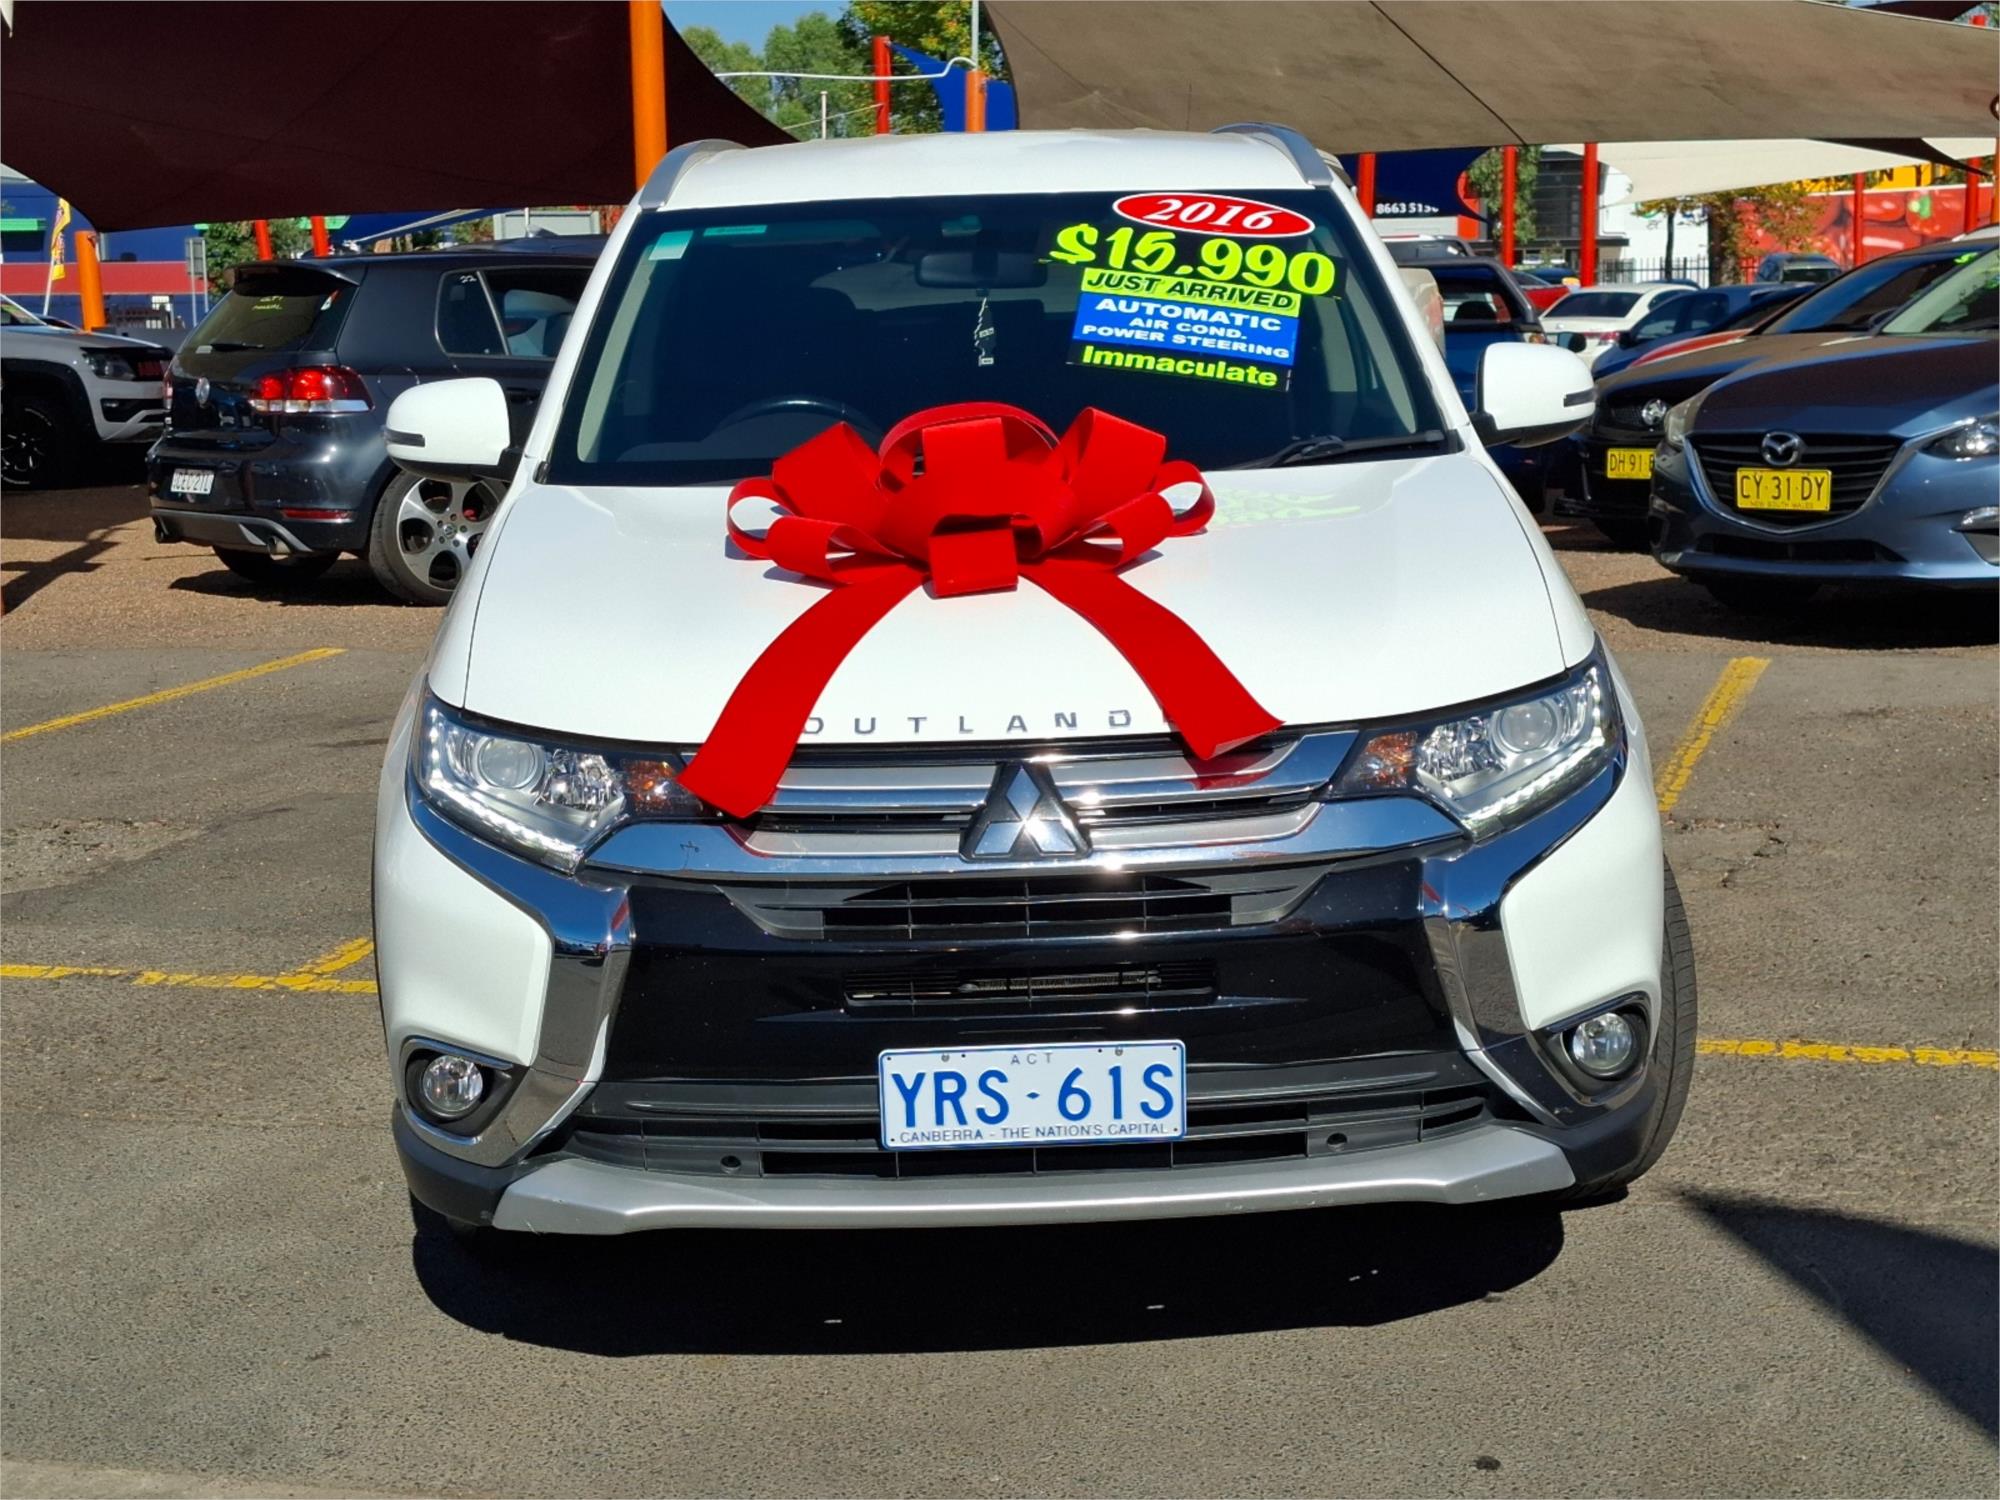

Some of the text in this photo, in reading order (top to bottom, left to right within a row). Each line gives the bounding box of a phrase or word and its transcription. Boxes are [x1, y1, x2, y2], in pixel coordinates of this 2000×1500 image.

[1142, 198, 1283, 231] 2016
[1376, 202, 1407, 214] 8663
[1049, 223, 1335, 296] $15.990
[1087, 272, 1294, 309] JUST ARRIVED
[1095, 298, 1282, 331] AUTOMATIC
[1129, 317, 1247, 340] AIR COND.
[1082, 324, 1290, 359] POWER STEERING
[1082, 345, 1278, 387] Immaculate
[803, 709, 1172, 735] OUTLAND
[900, 1129, 984, 1143] CANBERRA
[1001, 1126, 1031, 1139] THE
[1108, 1123, 1169, 1136] CAPITAL
